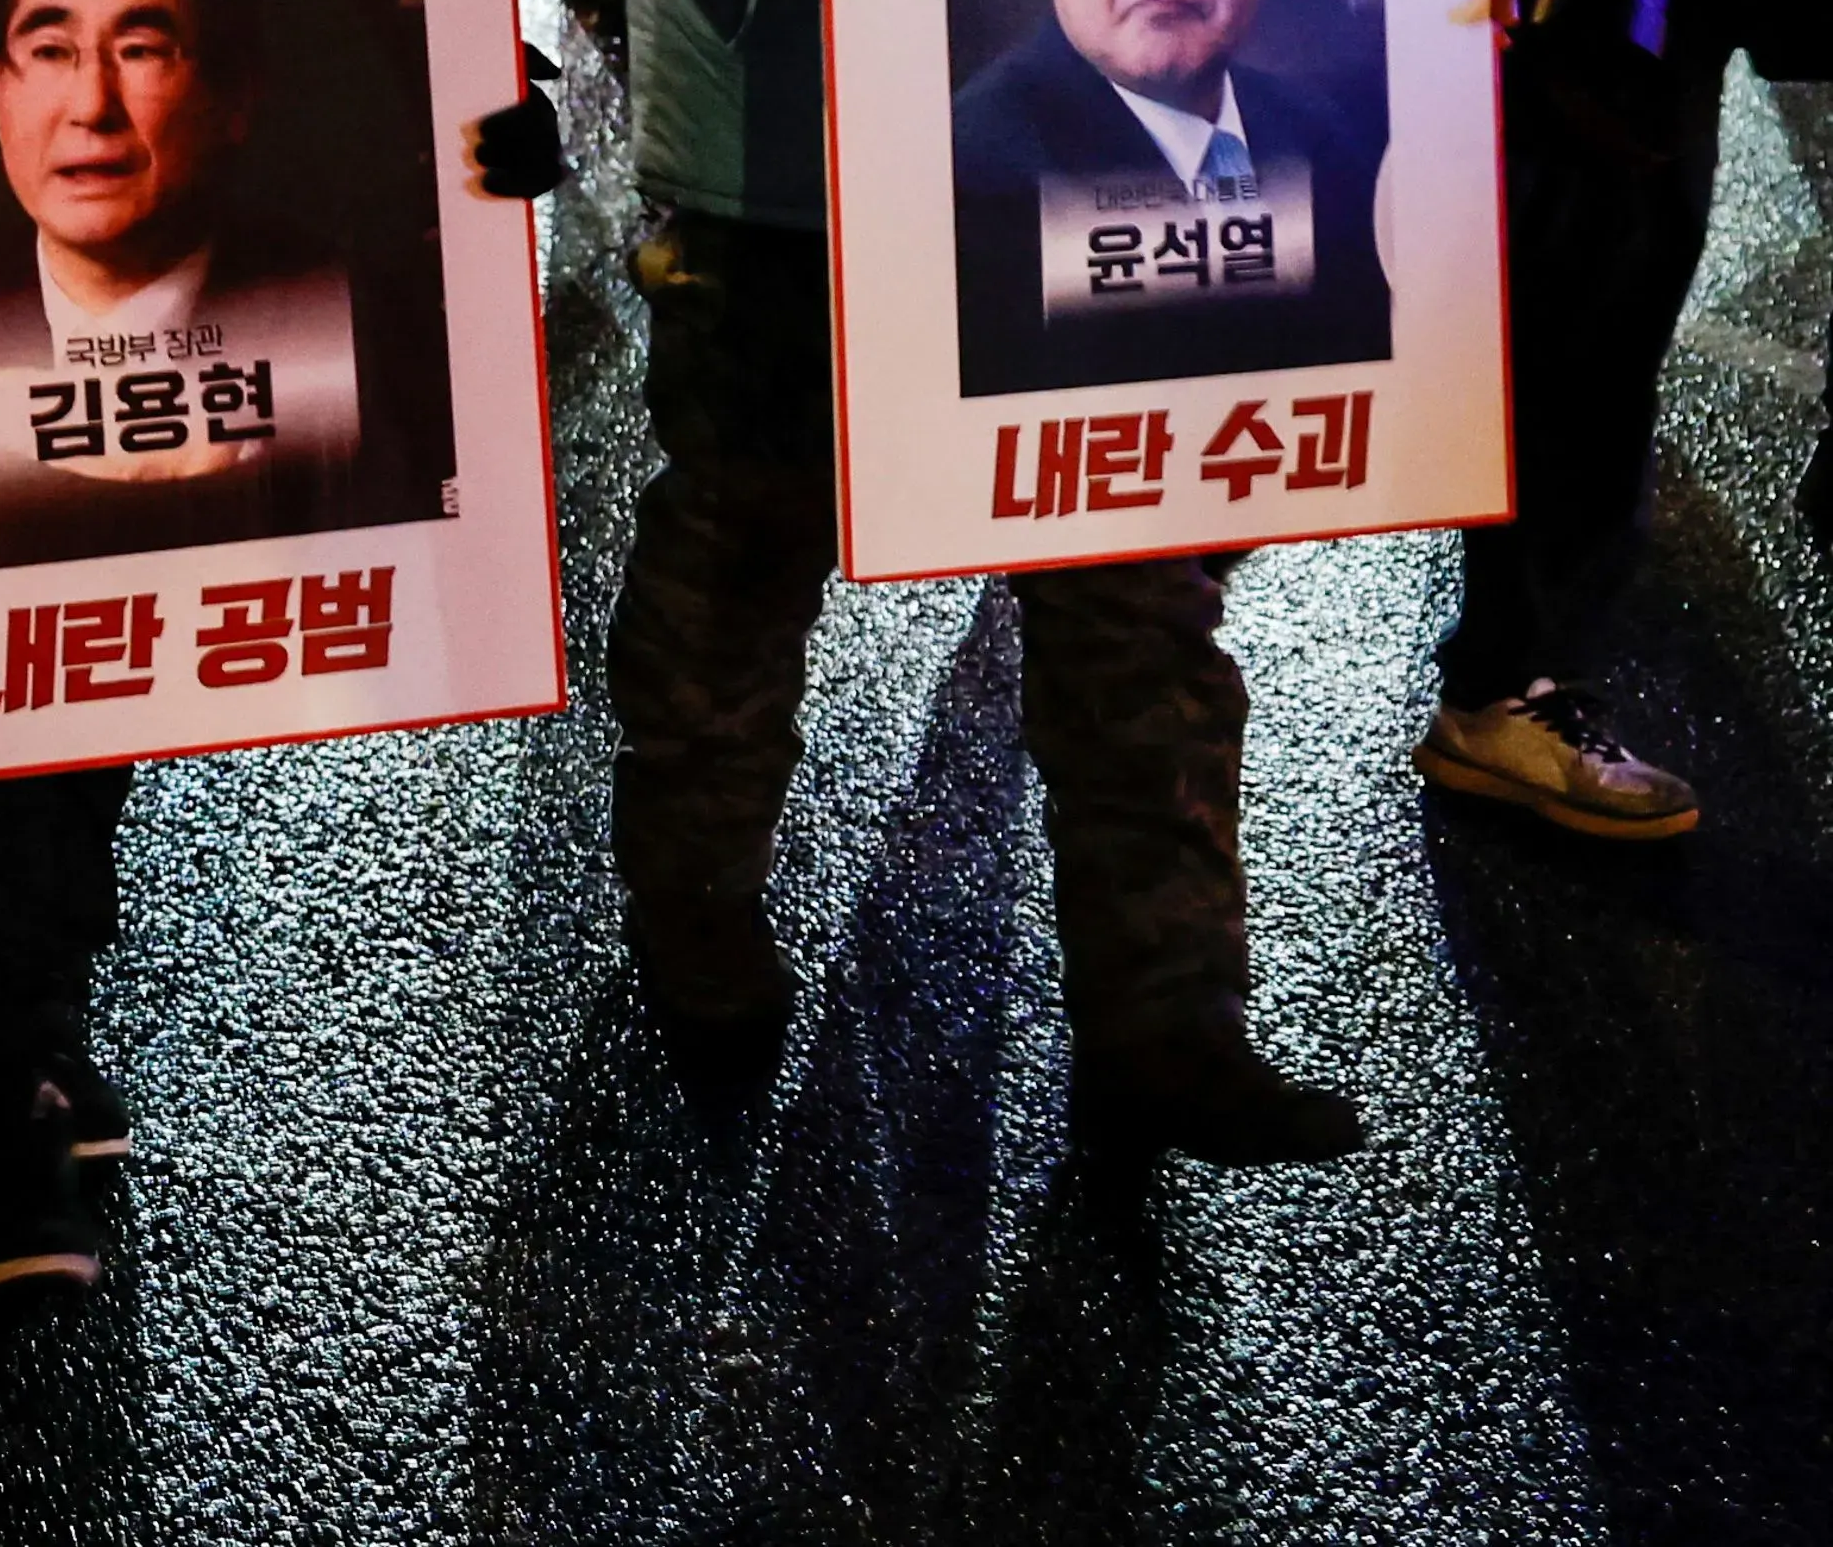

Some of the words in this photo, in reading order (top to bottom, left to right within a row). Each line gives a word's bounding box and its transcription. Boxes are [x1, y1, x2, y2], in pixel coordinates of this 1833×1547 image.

[1086, 213, 1276, 295] 윤석열
[65, 331, 158, 369] 국방부
[164, 323, 224, 360] 장관
[28, 359, 277, 462] 김용현
[991, 409, 1175, 520] 내란
[1200, 391, 1374, 503] 수괴
[195, 565, 396, 689] 공범
